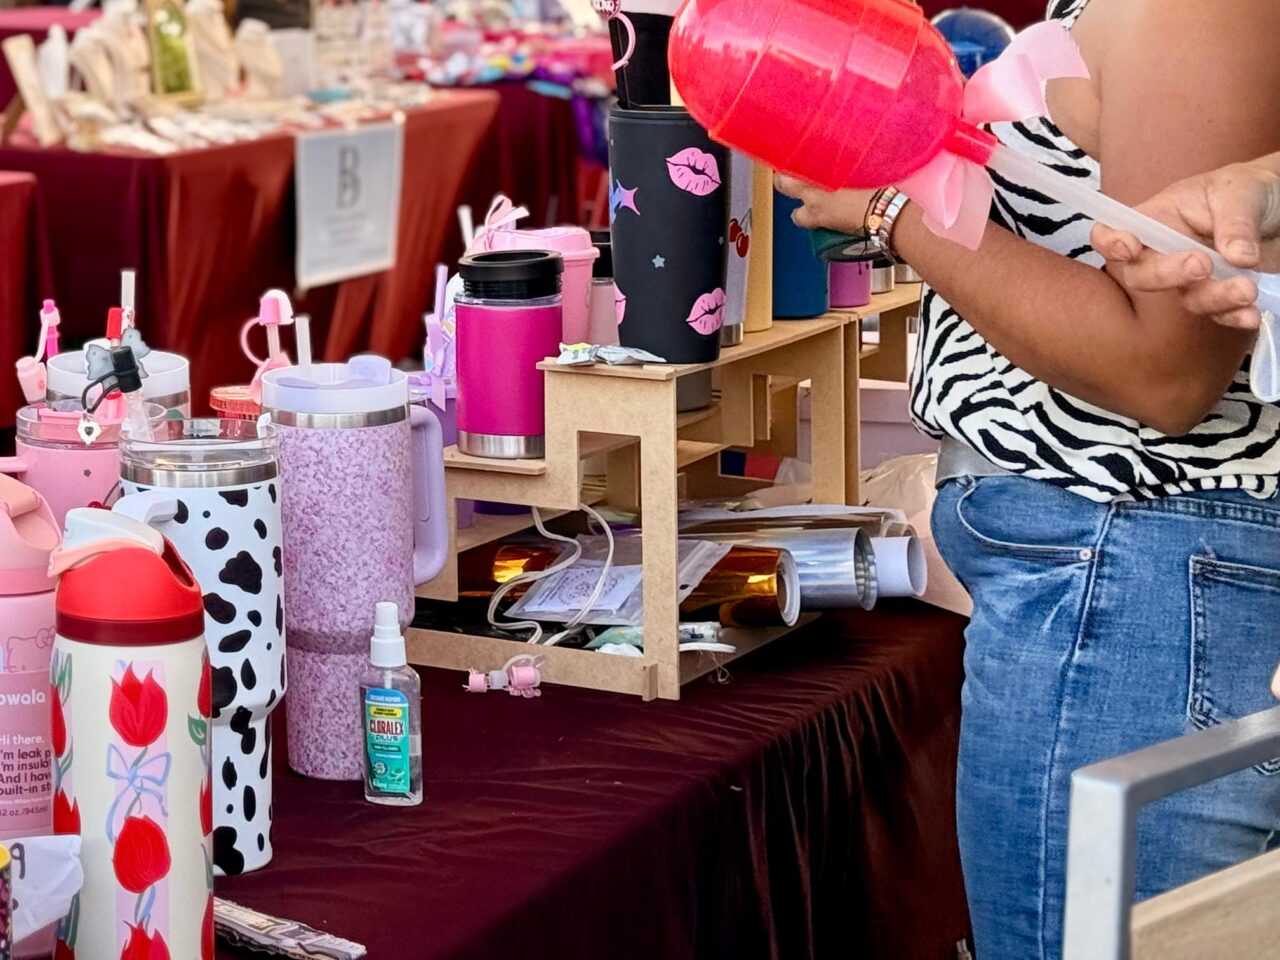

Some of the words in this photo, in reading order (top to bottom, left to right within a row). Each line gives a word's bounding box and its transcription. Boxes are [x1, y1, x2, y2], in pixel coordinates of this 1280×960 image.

[370, 719, 404, 736] CLORALEX
[13, 733, 45, 745] there.
[17, 747, 42, 760] leak
[17, 759, 51, 771] insula
